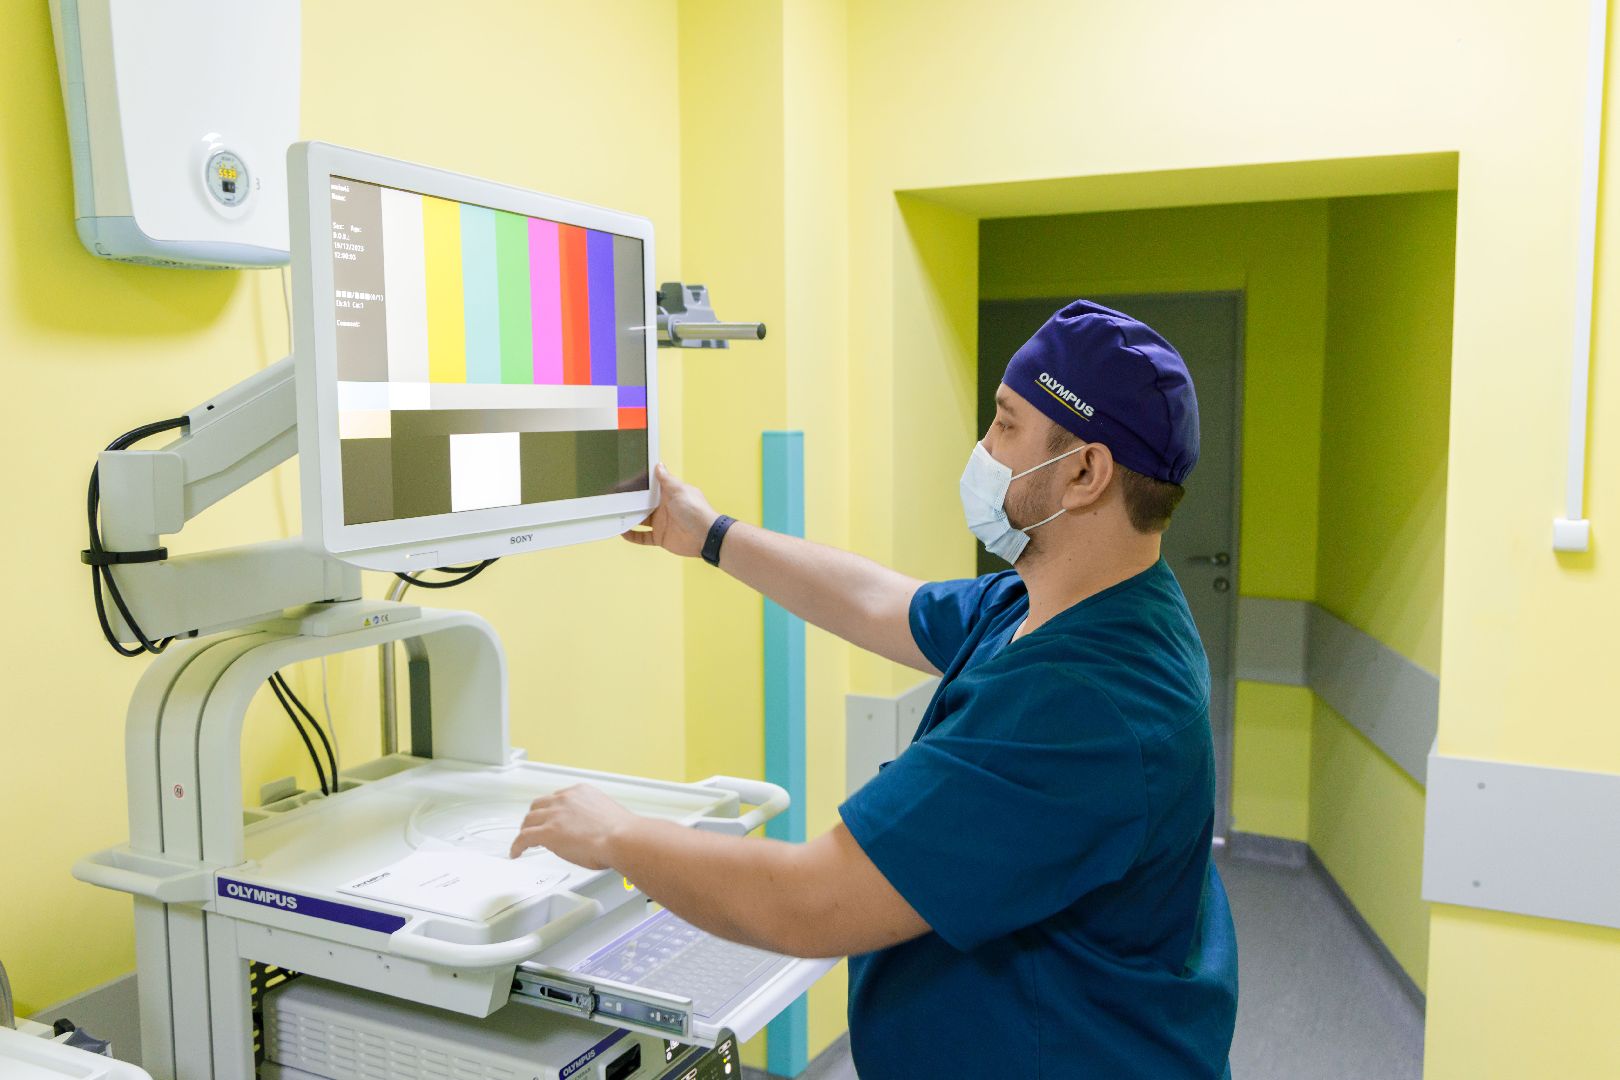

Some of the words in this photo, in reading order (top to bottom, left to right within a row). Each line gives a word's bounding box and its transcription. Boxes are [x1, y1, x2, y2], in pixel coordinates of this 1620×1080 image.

[1038, 372, 1095, 417] OLYMPUS
[510, 533, 533, 545] SONY
[226, 883, 298, 910] OLYMPUS
[562, 1049, 596, 1077] OLYMPUS
